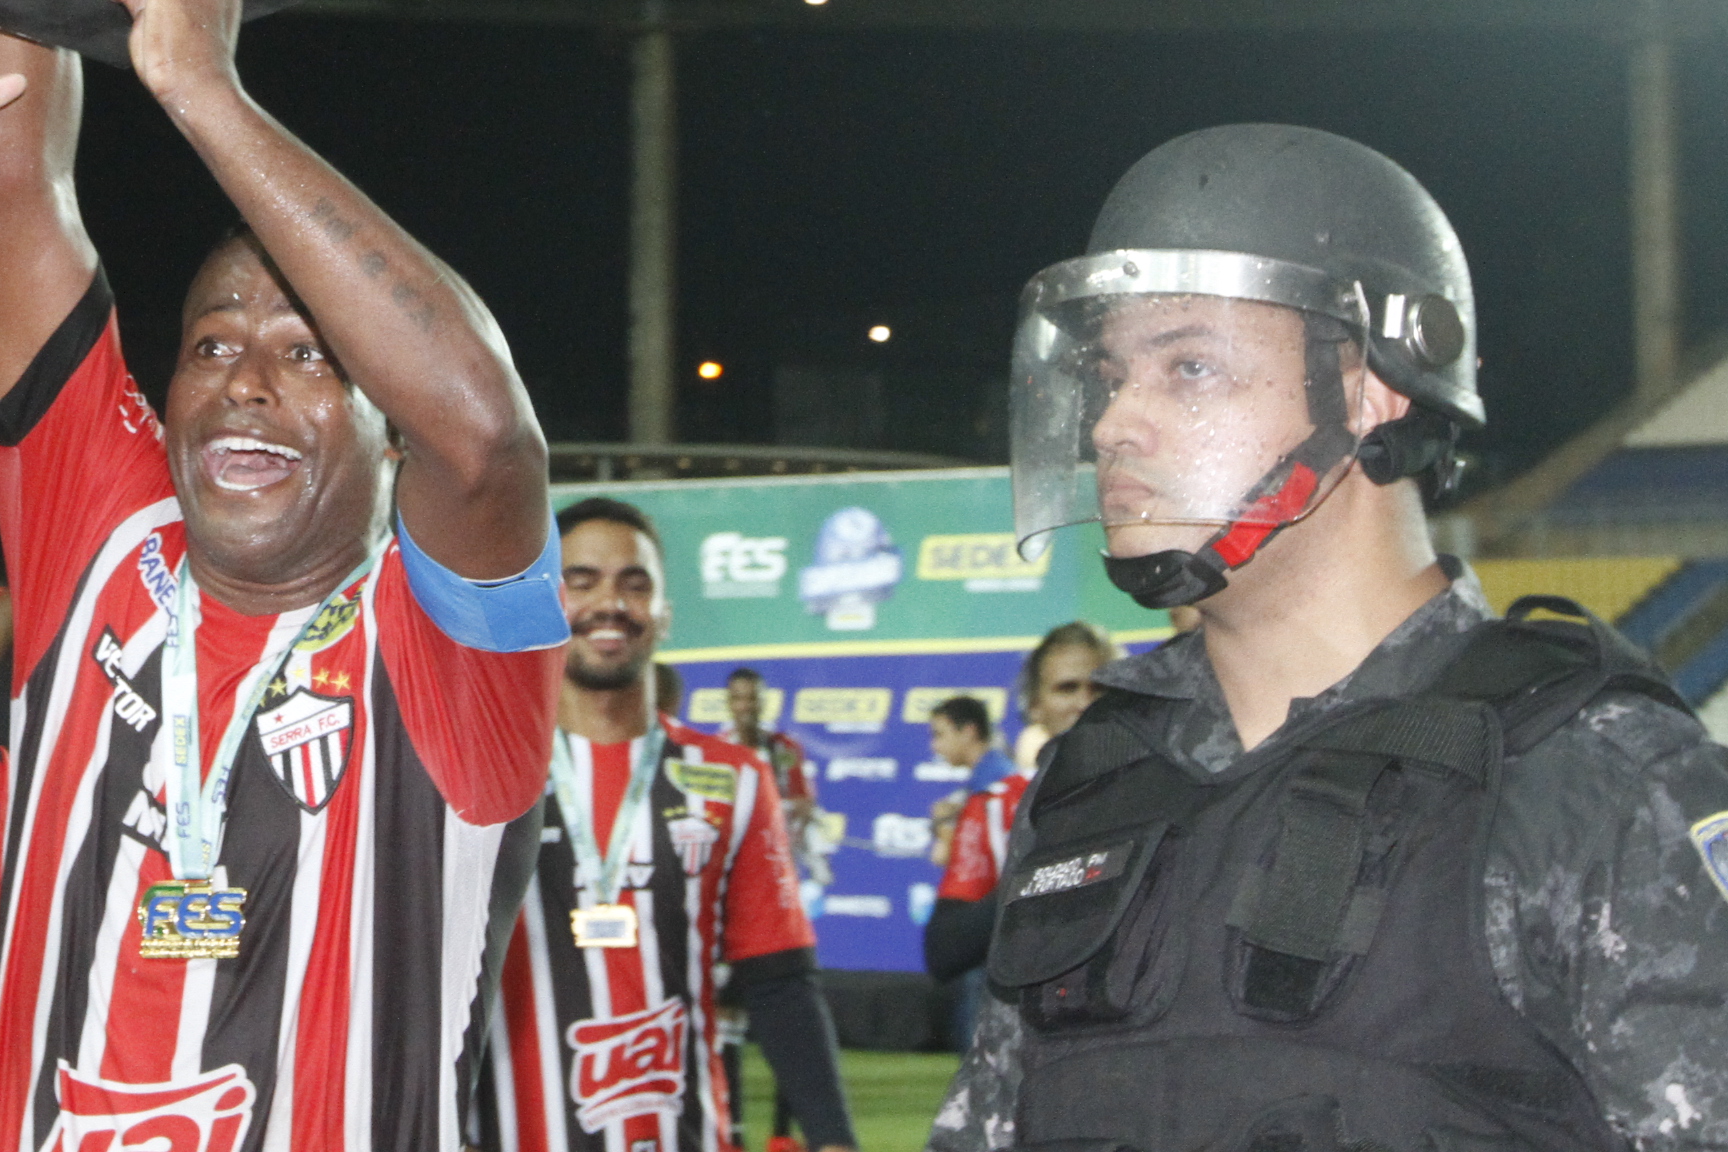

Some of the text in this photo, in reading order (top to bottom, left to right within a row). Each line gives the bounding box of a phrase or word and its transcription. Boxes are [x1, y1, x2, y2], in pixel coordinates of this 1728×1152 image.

[700, 531, 788, 582] FES
[173, 714, 187, 766] SEDEX
[270, 725, 313, 748] SERRA
[175, 801, 190, 839] FES
[146, 892, 246, 939] FES
